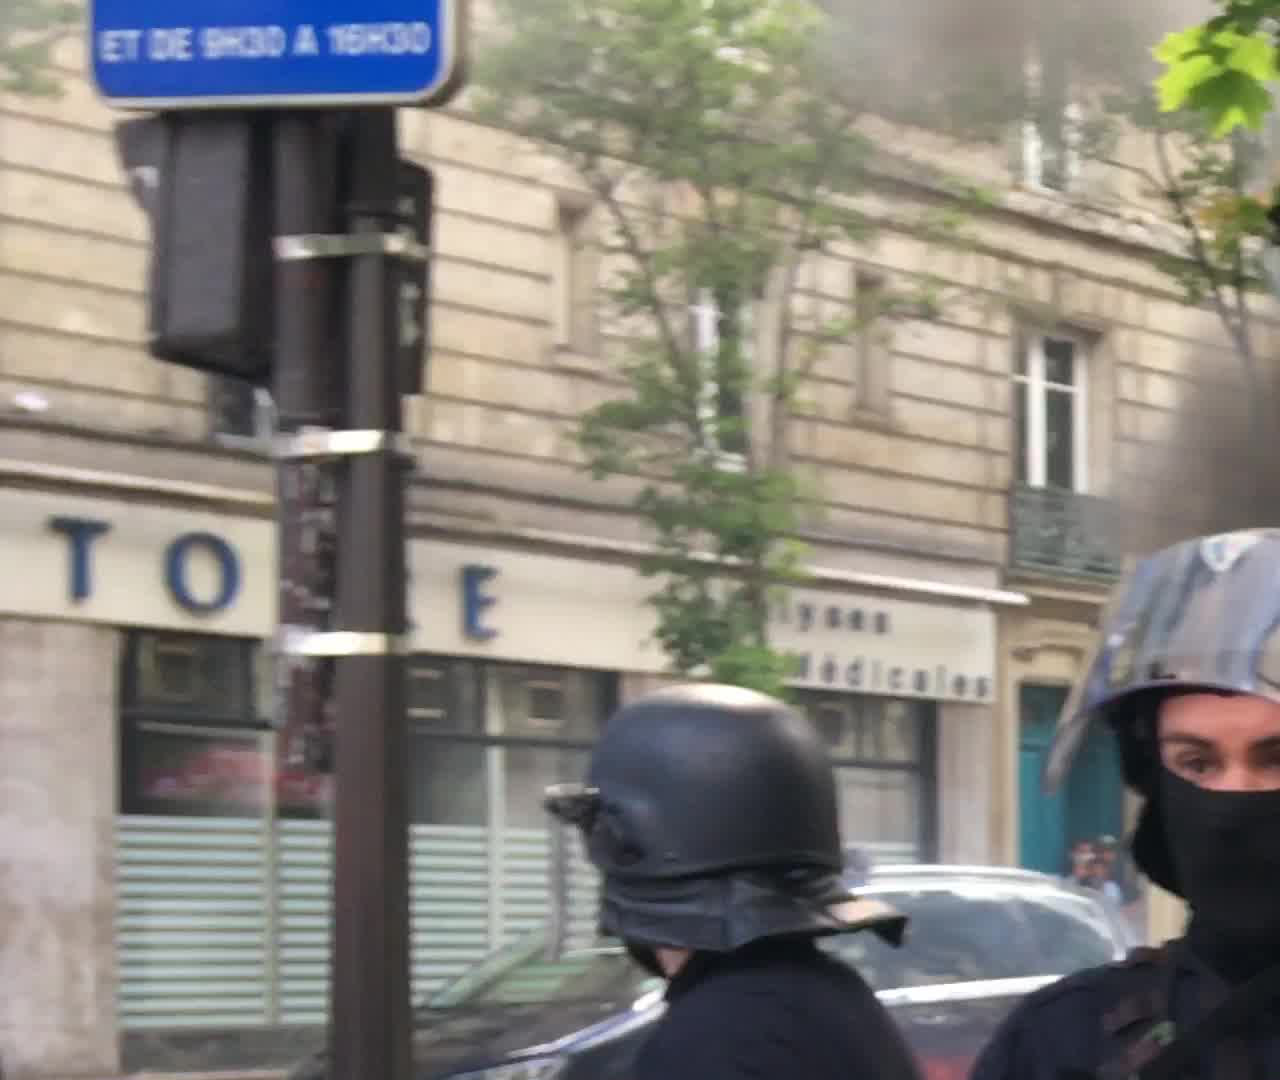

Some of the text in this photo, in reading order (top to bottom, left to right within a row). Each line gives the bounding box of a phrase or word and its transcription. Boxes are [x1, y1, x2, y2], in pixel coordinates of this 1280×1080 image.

[101, 29, 140, 62] ET
[147, 27, 193, 61] DE
[292, 23, 321, 56] A
